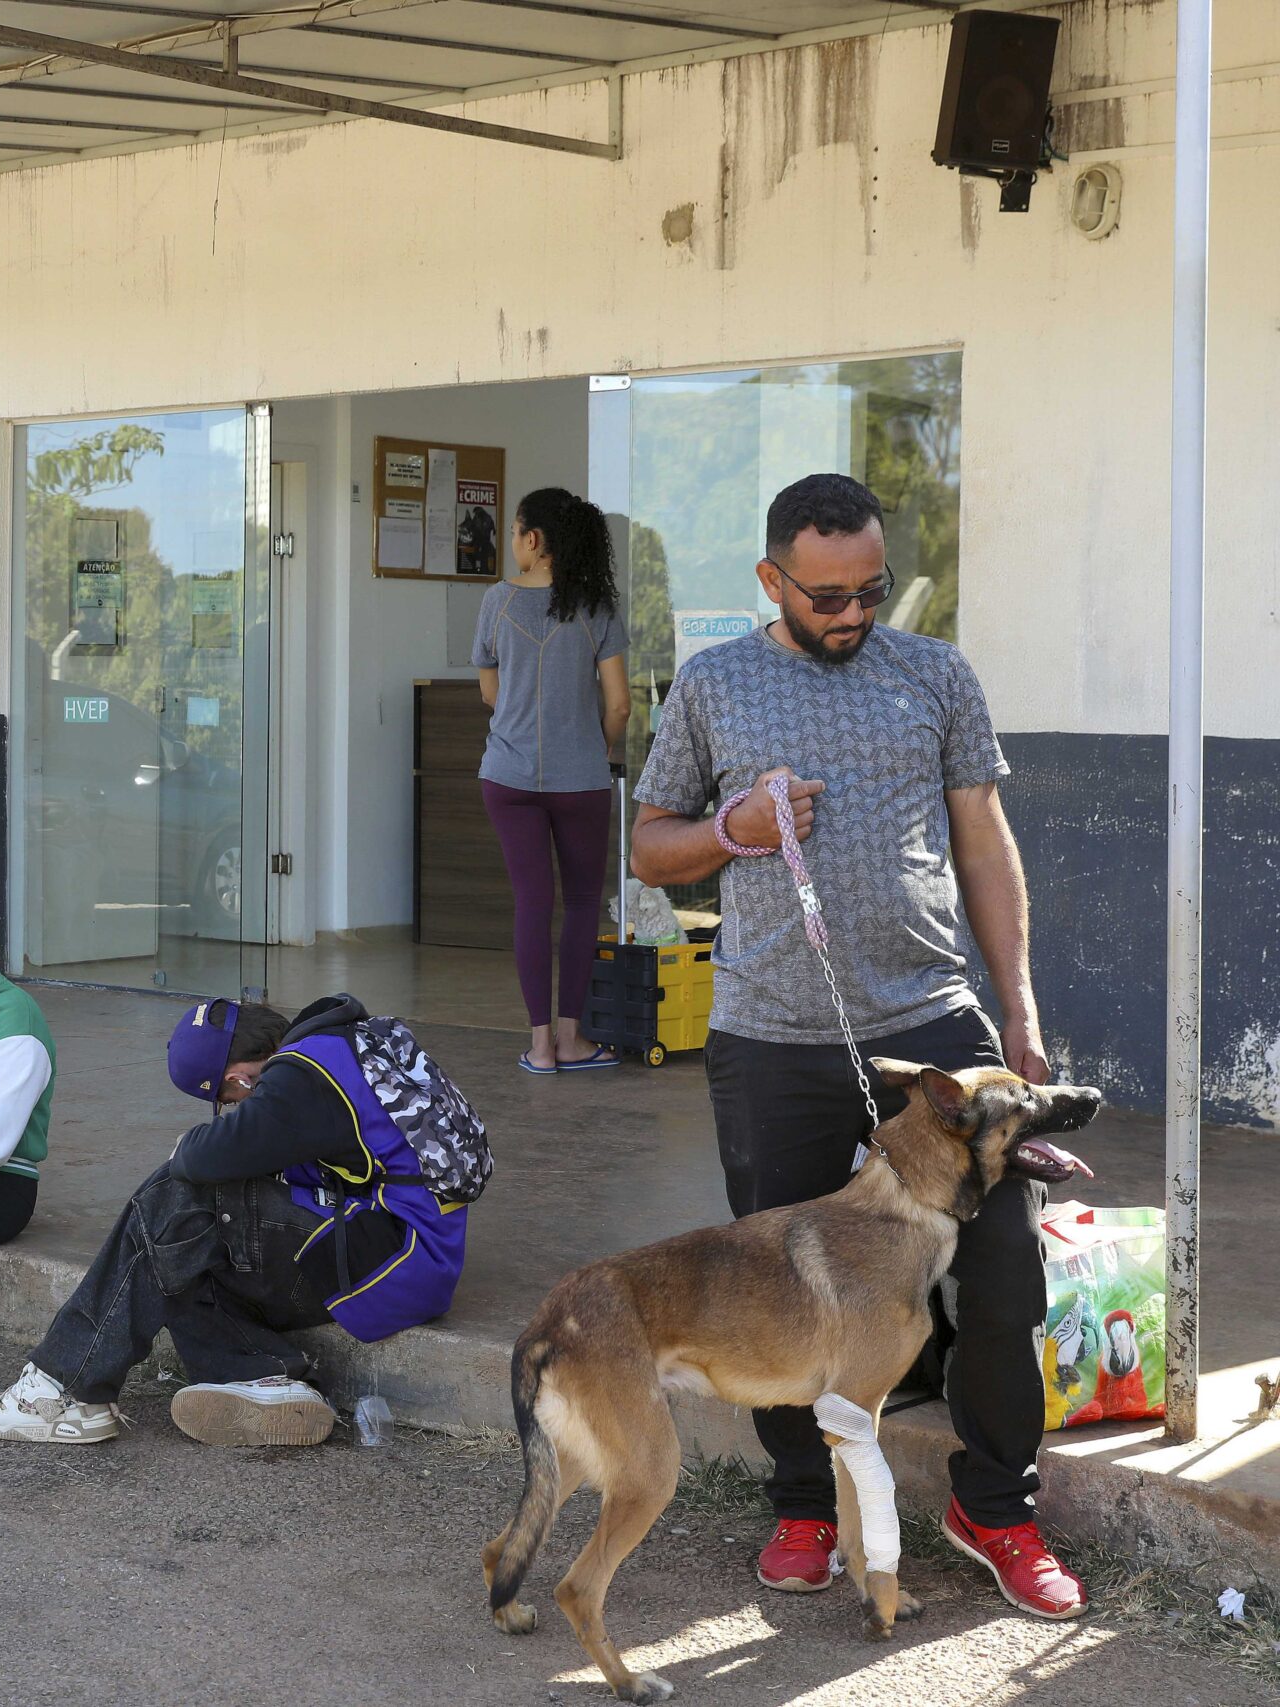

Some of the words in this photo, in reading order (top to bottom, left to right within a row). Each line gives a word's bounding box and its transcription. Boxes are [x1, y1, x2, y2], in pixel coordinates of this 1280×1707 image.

[464, 490, 495, 504] CRIME
[83, 562, 116, 573] ATENÇÃO
[683, 621, 707, 633] POR
[710, 620, 748, 633] FAVOR
[65, 700, 109, 719] HVEP
